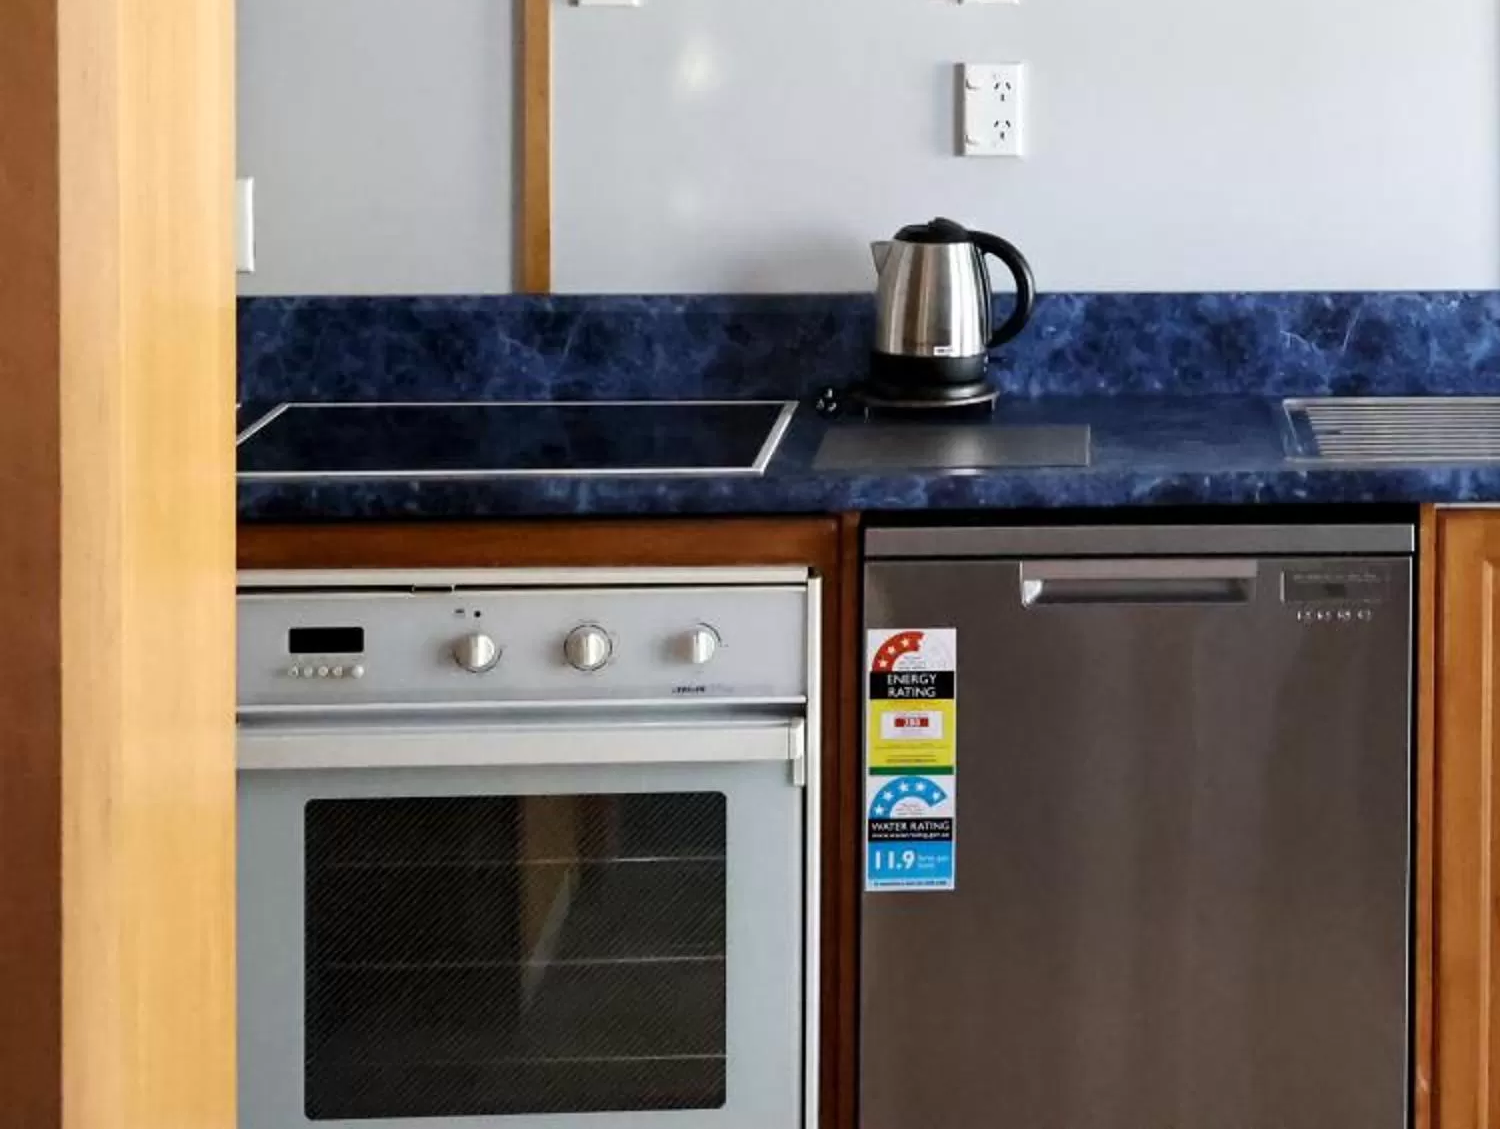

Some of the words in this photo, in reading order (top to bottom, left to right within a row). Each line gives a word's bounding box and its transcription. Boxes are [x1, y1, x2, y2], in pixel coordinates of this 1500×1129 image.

[887, 673, 937, 686] ENERGY
[887, 686, 937, 698] RATING
[871, 822, 908, 832] WATER
[910, 820, 950, 832] RATING
[875, 850, 915, 870] 11.9
